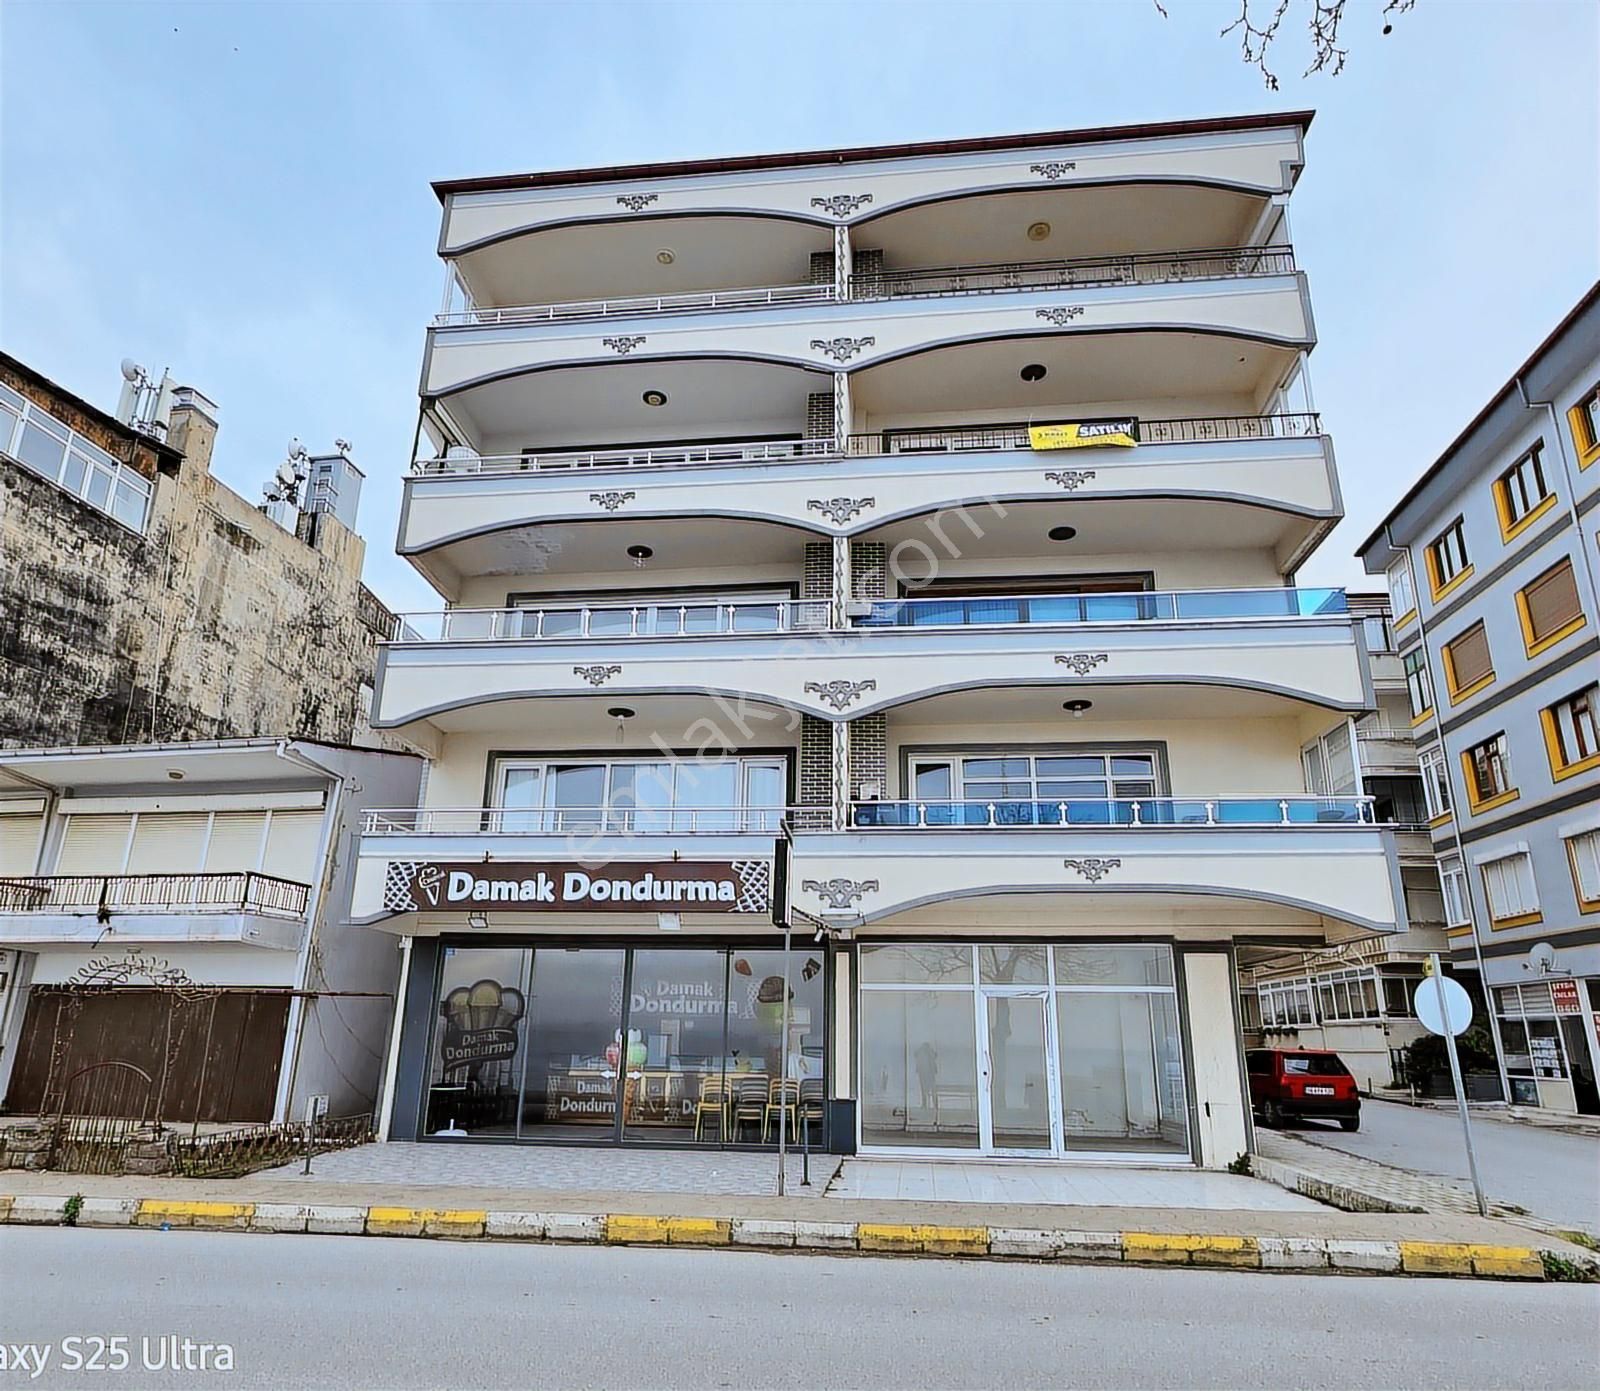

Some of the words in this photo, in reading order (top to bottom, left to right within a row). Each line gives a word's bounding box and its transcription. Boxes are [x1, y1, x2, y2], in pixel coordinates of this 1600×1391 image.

[447, 871, 556, 902] Damak
[562, 871, 736, 902] Dondurma
[656, 980, 713, 997] Damak
[629, 994, 738, 1014] Dondurma
[462, 1030, 499, 1046] Damak
[446, 1041, 515, 1060] Dondurma
[577, 1080, 613, 1094] Damak
[560, 1096, 616, 1113] Dondurm
